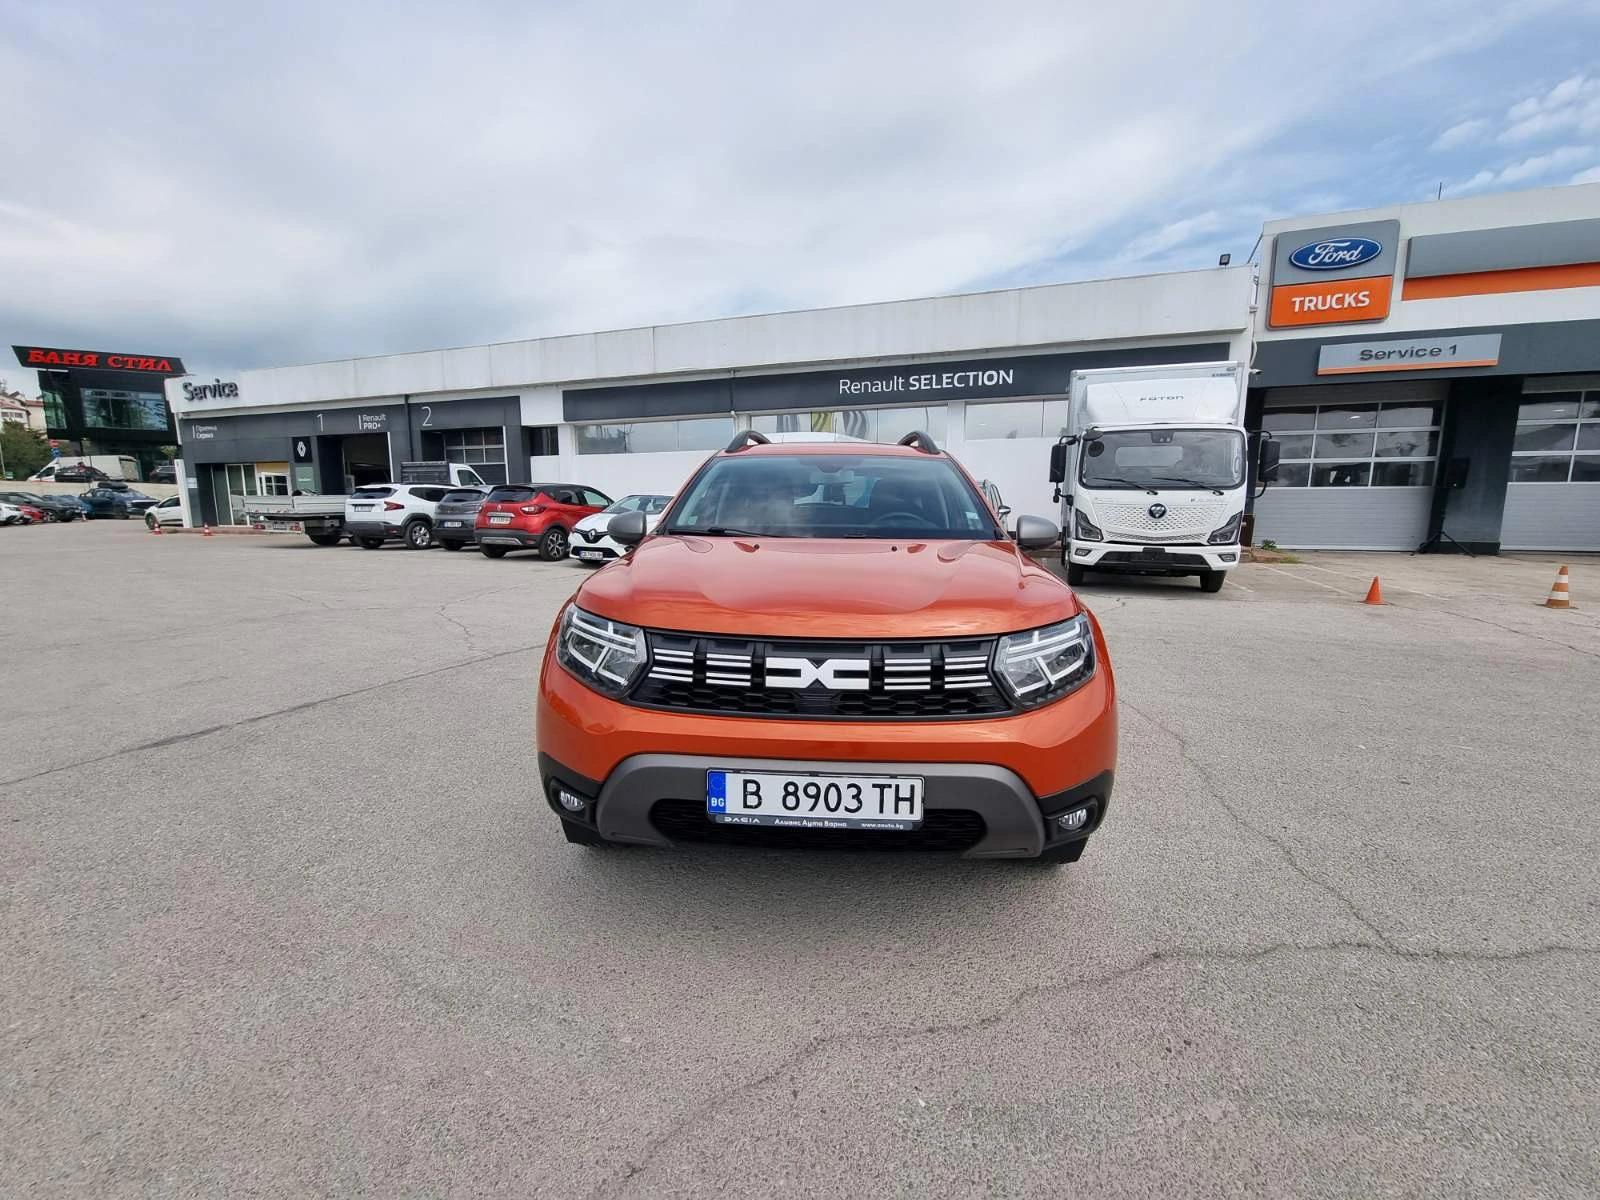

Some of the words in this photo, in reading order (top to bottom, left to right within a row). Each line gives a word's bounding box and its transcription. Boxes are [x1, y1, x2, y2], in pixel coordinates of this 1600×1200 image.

[1307, 241, 1363, 265] Ford
[1291, 290, 1371, 313] TRUCKS
[27, 349, 99, 368] БАНЯ
[106, 355, 174, 372] СТИЛ
[1359, 345, 1443, 362] Service
[1448, 344, 1458, 357] 1
[182, 378, 239, 402] Service
[839, 375, 905, 395] Renault
[908, 369, 1014, 391] SELECTION
[316, 413, 324, 433] 1
[362, 413, 387, 422] Renault
[421, 406, 433, 427] 2
[711, 797, 725, 807] BG
[742, 779, 763, 810] B
[781, 781, 863, 813] 8903
[871, 783, 915, 815] TH
[724, 816, 761, 824] DACIA
